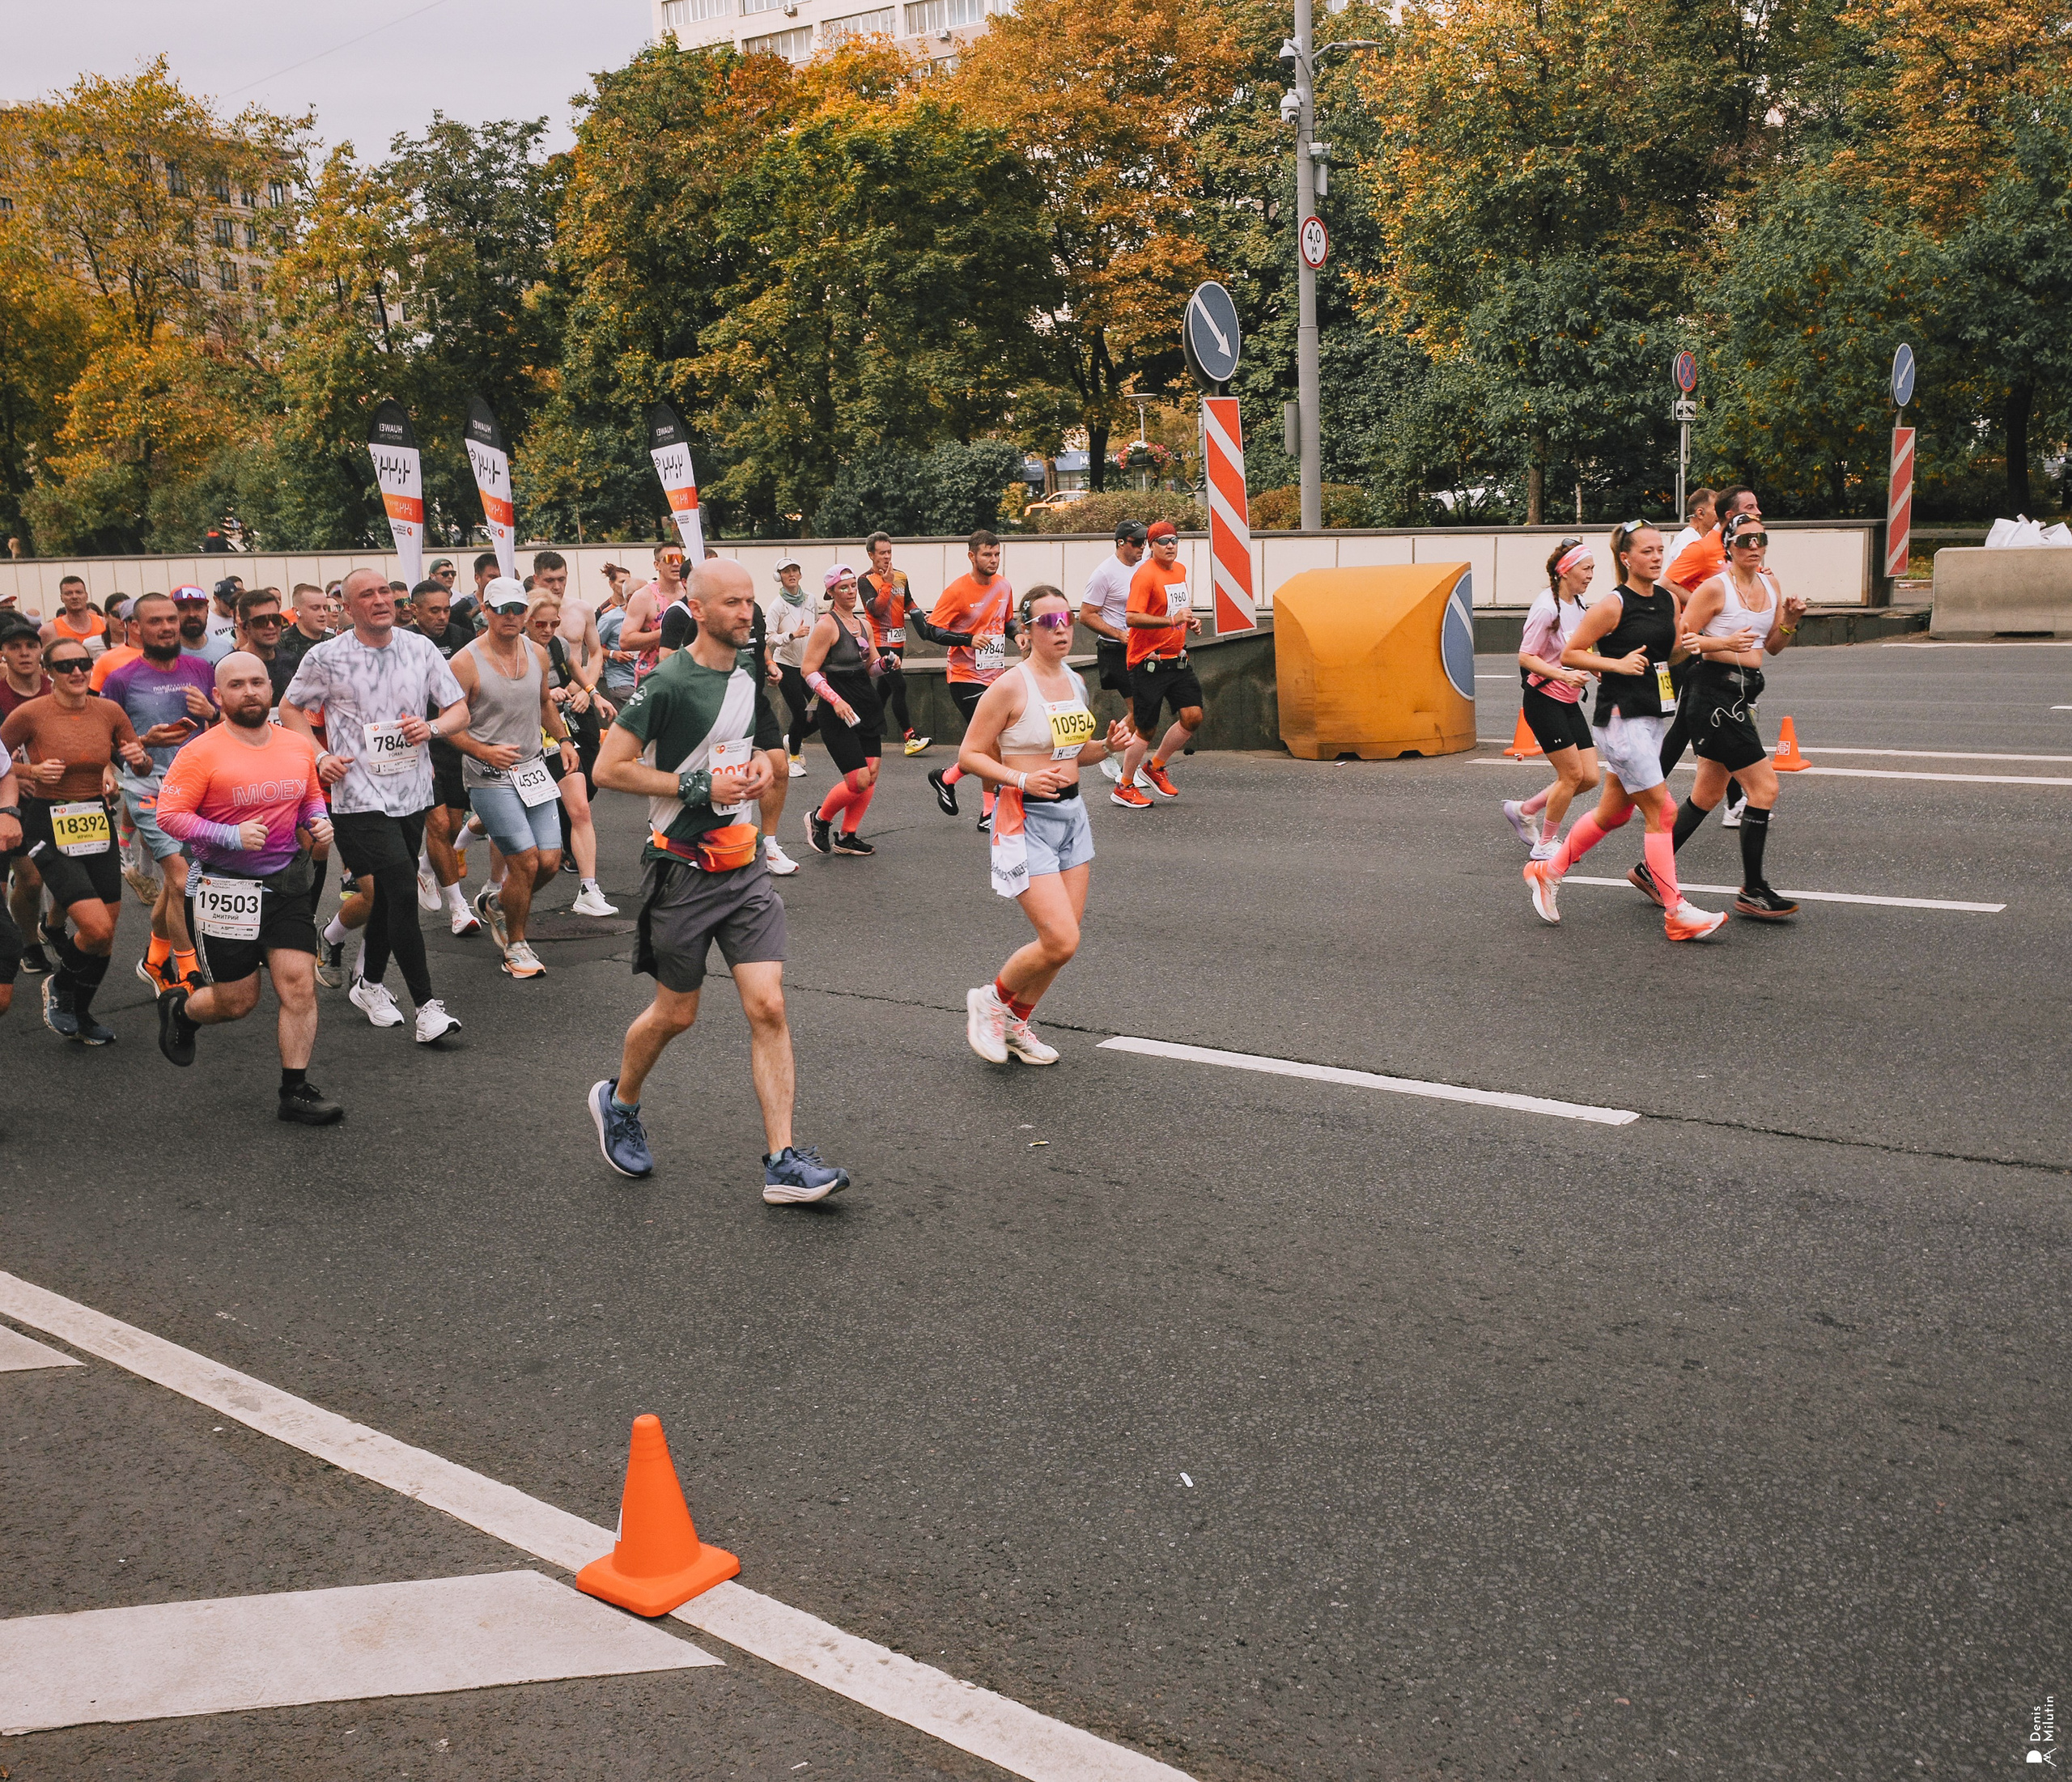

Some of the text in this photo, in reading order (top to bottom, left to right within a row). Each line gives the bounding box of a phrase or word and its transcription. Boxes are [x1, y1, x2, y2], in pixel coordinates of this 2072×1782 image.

[1307, 228, 1321, 244] 4,0
[1170, 592, 1187, 604] 1960
[1052, 714, 1094, 736] 10954
[518, 769, 546, 789] 4533
[232, 779, 307, 807] MOEX
[56, 815, 108, 836] 18392
[199, 891, 259, 914] 19503
[212, 913, 240, 921] ДМИТРИЙ
